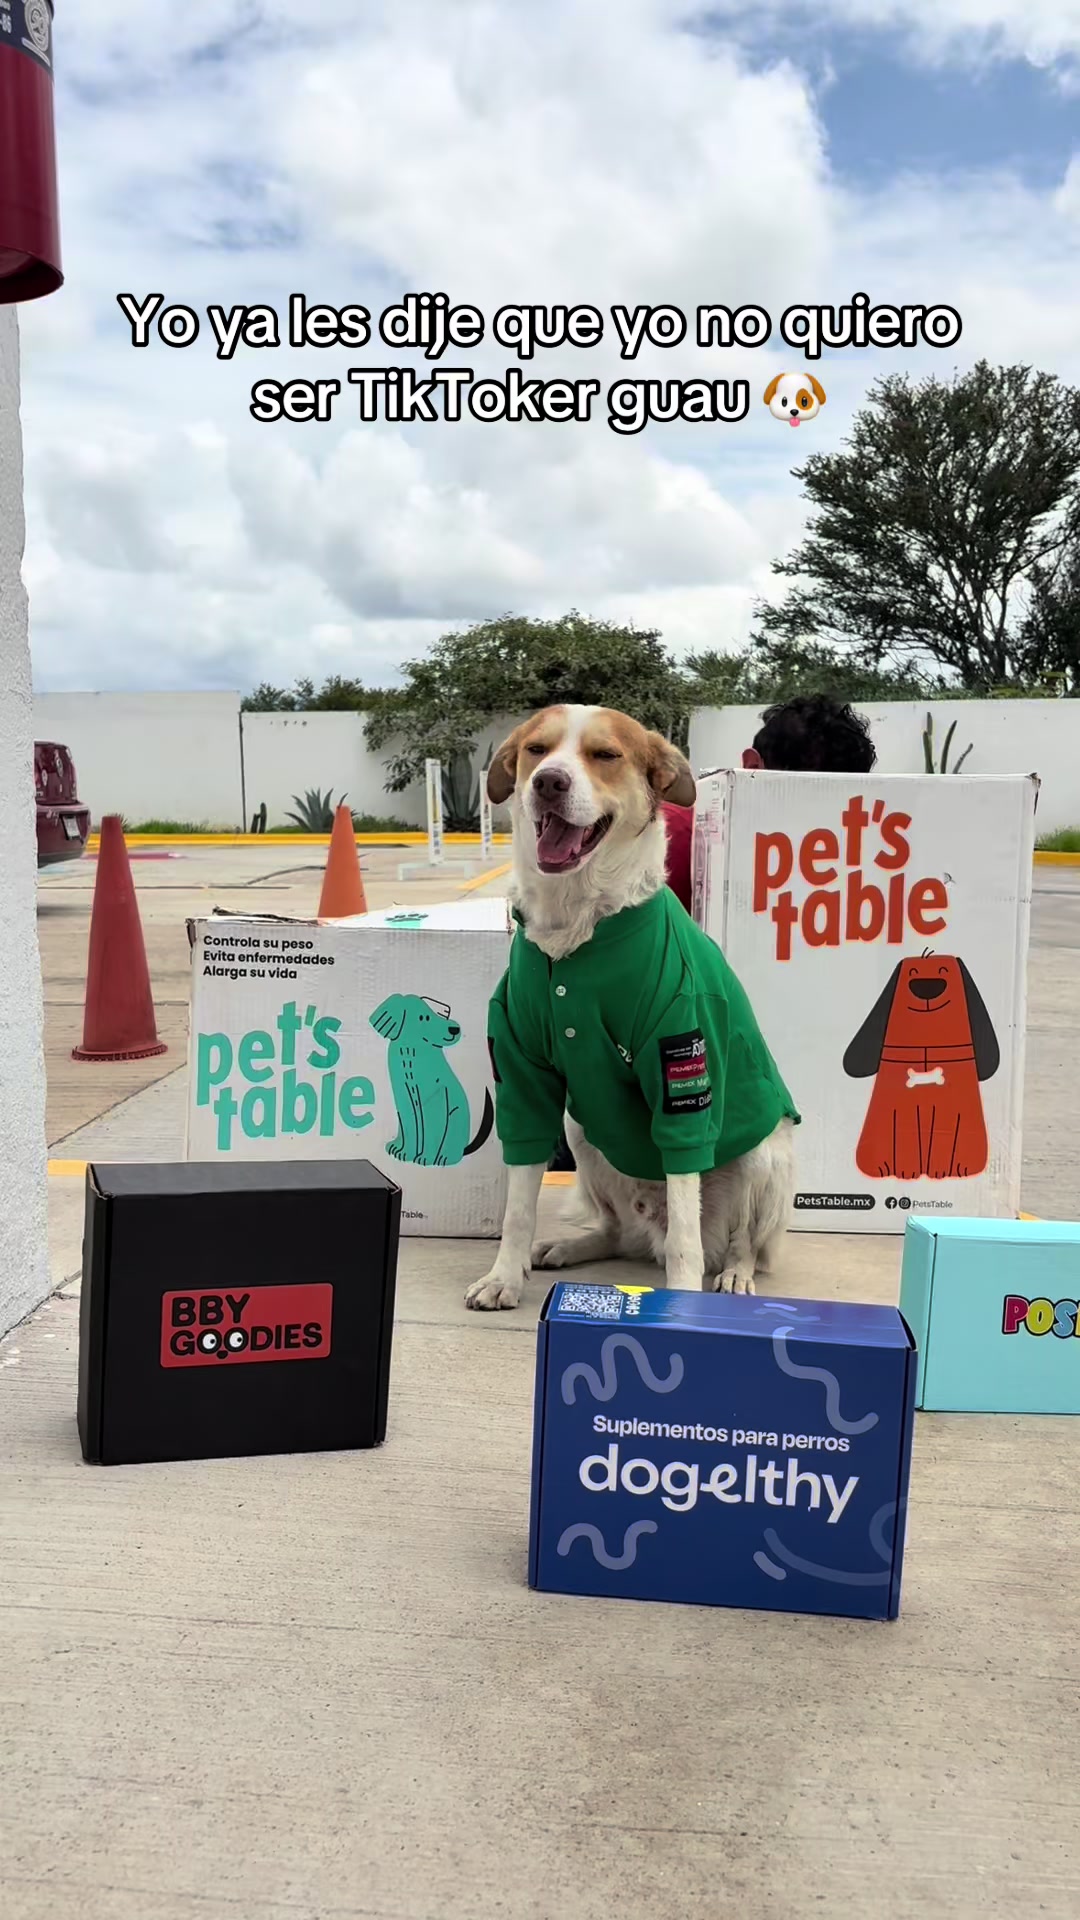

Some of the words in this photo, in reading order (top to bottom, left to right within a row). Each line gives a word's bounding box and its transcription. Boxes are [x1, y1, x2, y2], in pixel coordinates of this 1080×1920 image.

[753, 795, 912, 912] pet's
[772, 870, 949, 961] table
[203, 935, 260, 947] Controla
[263, 939, 279, 948] su
[281, 940, 314, 951] peso
[203, 950, 235, 962] Evita
[238, 951, 335, 965] enfermedades
[203, 965, 247, 980] Alarga
[250, 968, 266, 978] su
[268, 967, 297, 979] vida
[196, 1000, 342, 1106] pet's
[214, 1069, 375, 1151] table
[401, 1210, 424, 1219] Table
[796, 1196, 871, 1206] PetsTable.mx
[912, 1200, 953, 1208] PetsTable
[172, 1294, 250, 1327] BBY
[1002, 1294, 1080, 1338] POS
[170, 1323, 322, 1357] GOODIES
[593, 1415, 729, 1443] Suplementos
[732, 1429, 778, 1447] para
[782, 1432, 850, 1452] perros
[578, 1443, 859, 1523] dogelthy
